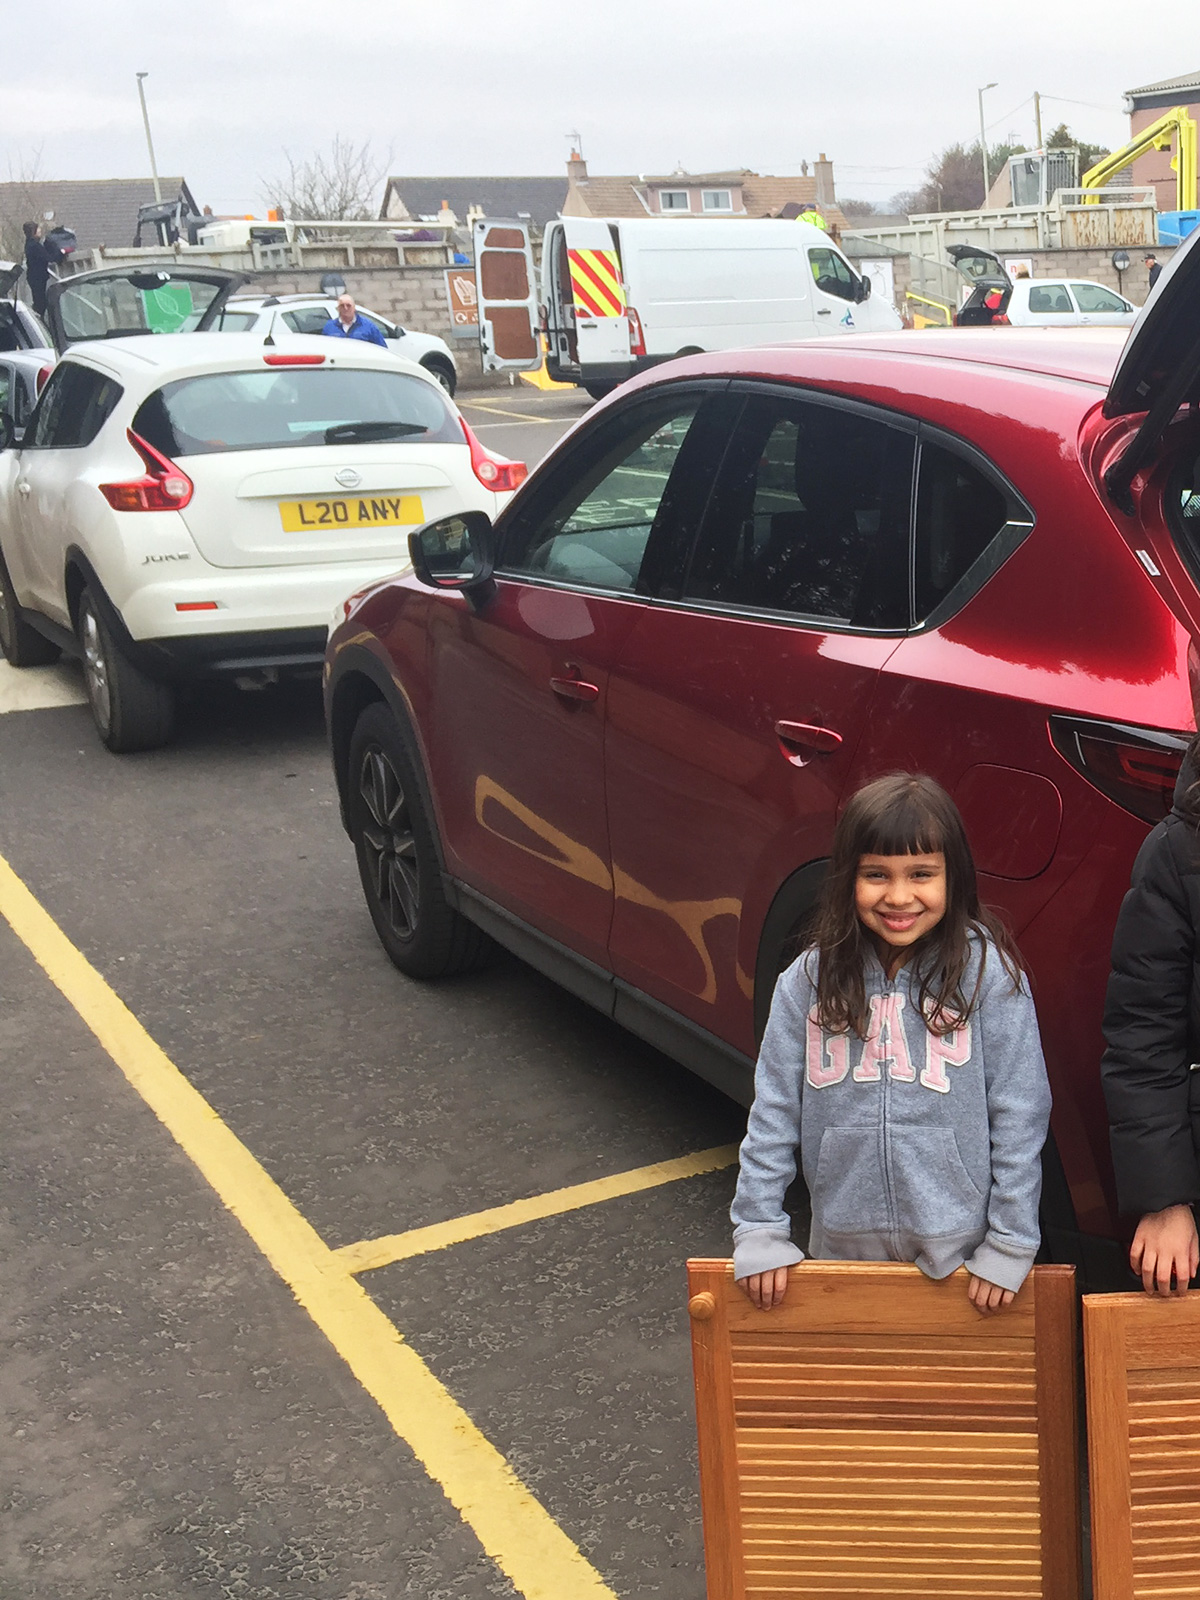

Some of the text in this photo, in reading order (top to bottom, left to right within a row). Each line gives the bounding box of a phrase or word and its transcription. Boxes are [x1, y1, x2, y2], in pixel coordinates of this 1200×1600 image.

[298, 498, 401, 525] L20 ANY
[141, 551, 191, 567] JUKE
[806, 992, 972, 1094] GAP
